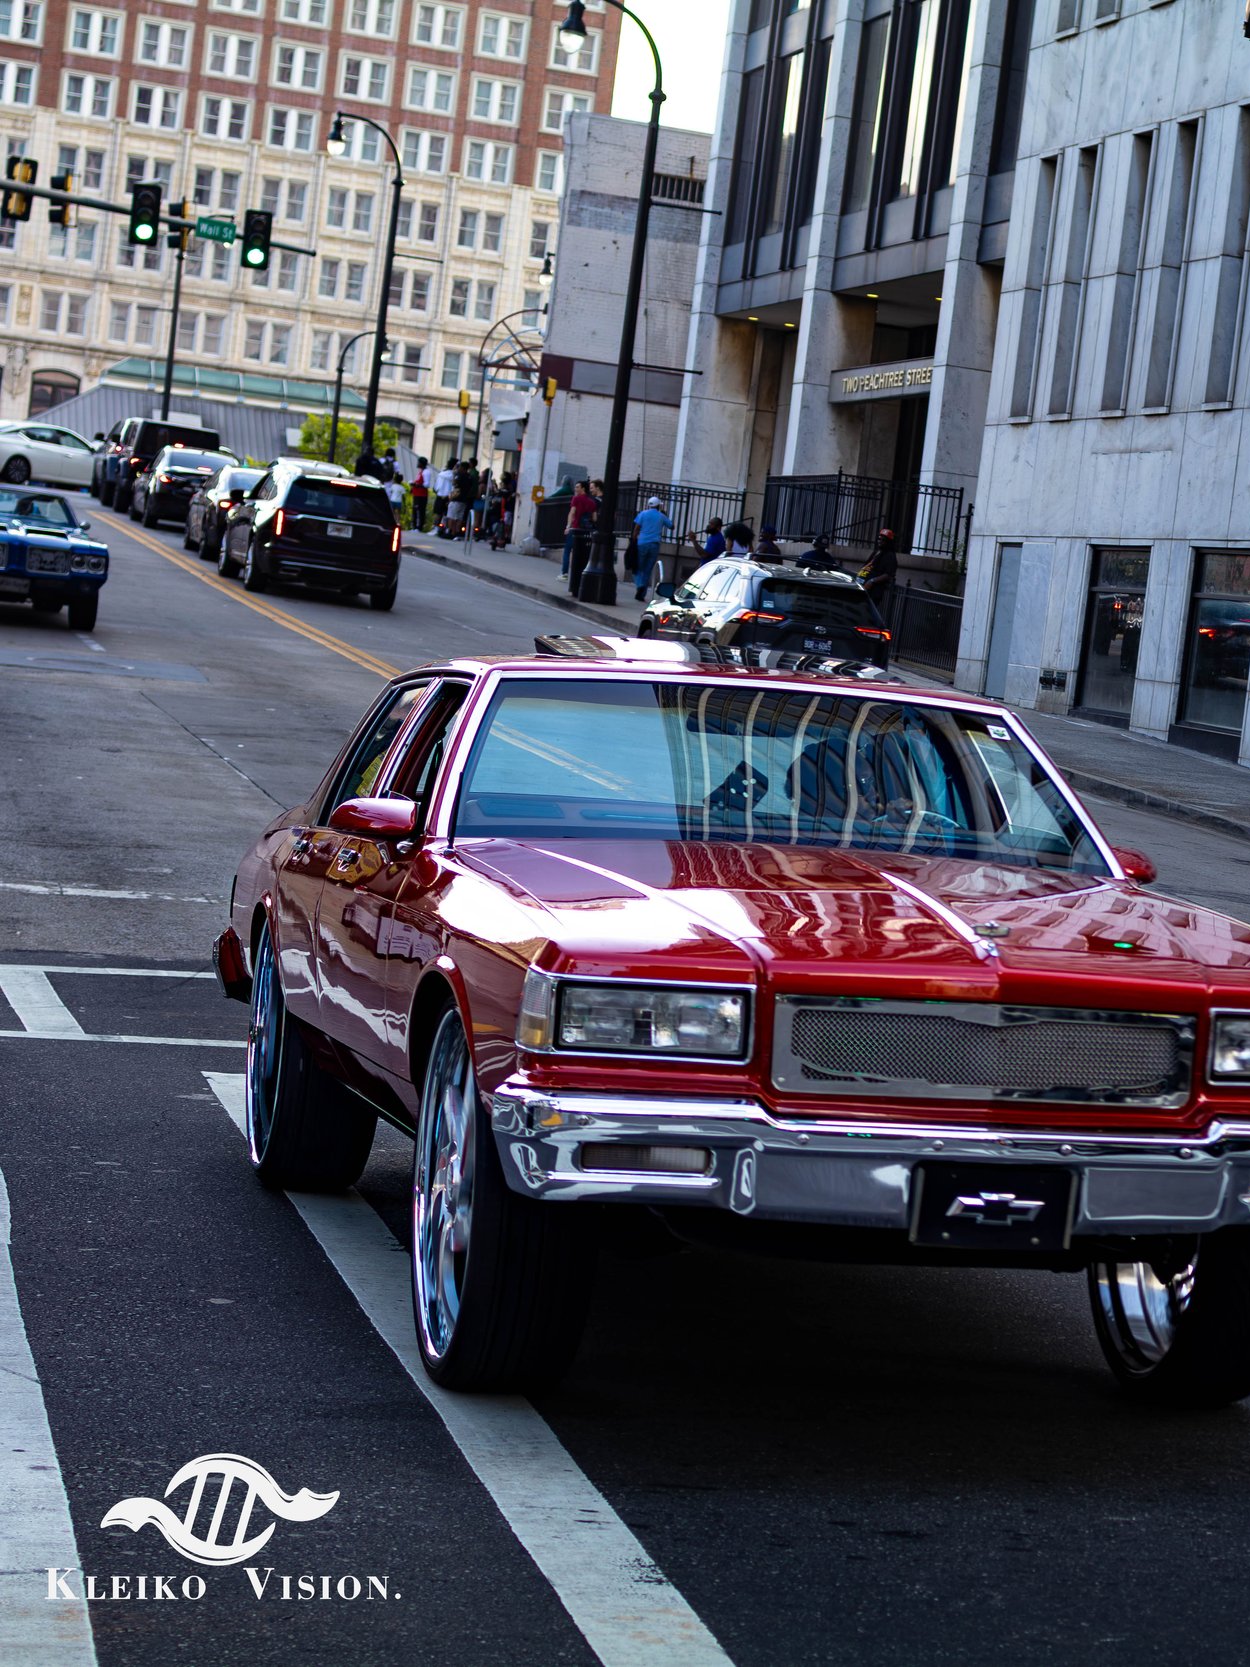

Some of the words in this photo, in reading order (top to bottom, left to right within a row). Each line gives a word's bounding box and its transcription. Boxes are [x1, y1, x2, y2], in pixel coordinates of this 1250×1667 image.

[200, 222, 220, 236] Wall
[222, 226, 233, 240] St
[842, 376, 859, 393] TWO
[860, 370, 904, 391] PEACHTREE
[906, 367, 933, 386] STREE
